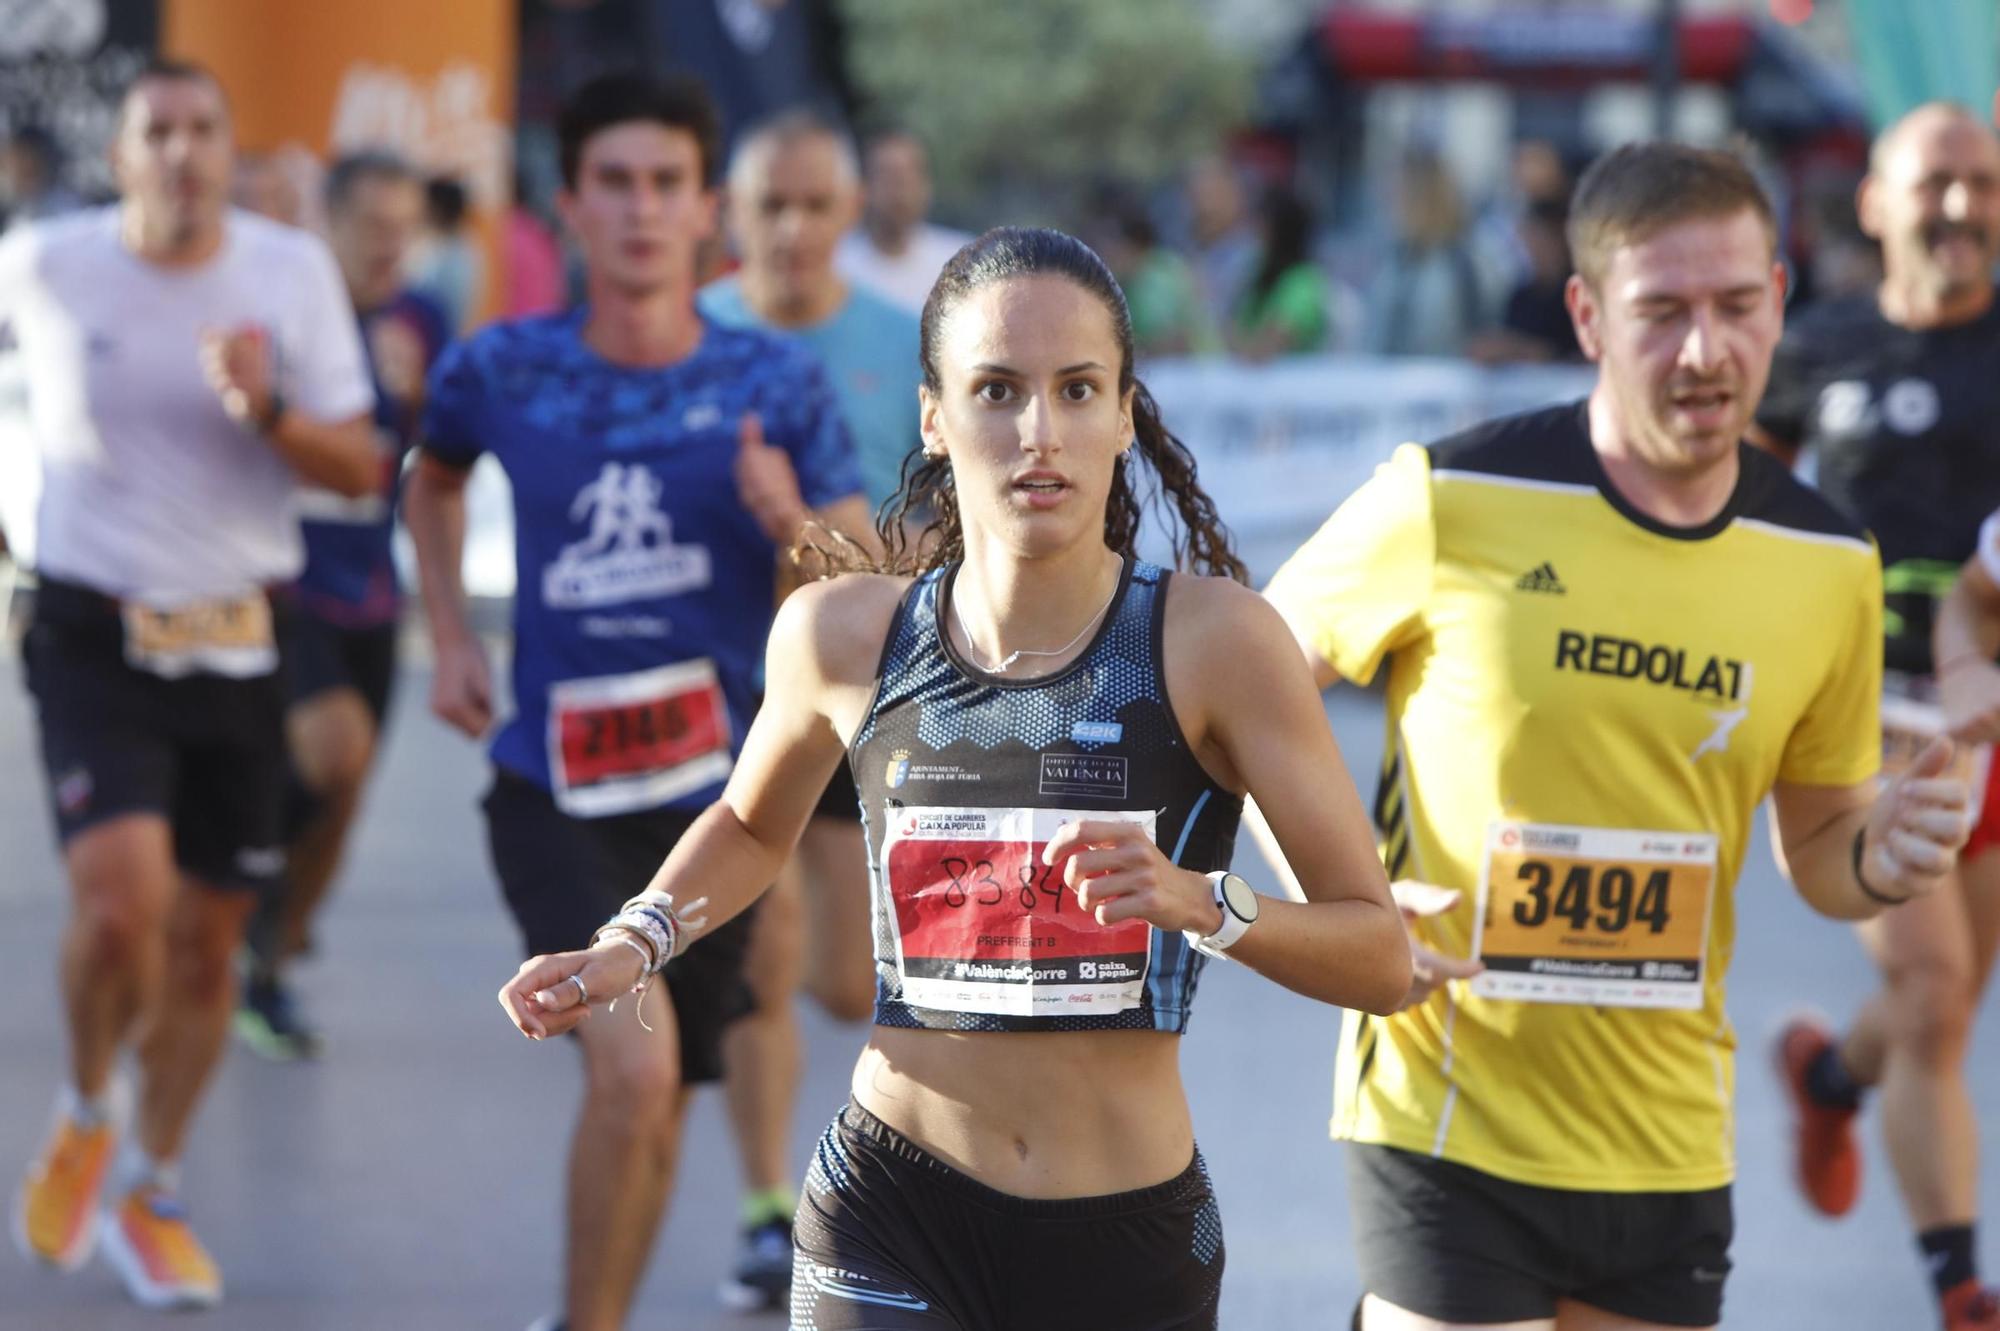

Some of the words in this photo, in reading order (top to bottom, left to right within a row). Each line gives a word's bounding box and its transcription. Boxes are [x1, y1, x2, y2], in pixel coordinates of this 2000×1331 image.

[954, 814, 986, 822] CARRERES
[919, 822, 951, 830] CAIXA
[952, 822, 986, 831] POPULAR
[1513, 860, 1671, 935] 3494
[976, 936, 1042, 948] PREFERENT
[1047, 938, 1056, 947] B
[1098, 962, 1126, 970] caixa
[1098, 968, 1139, 979] popular
